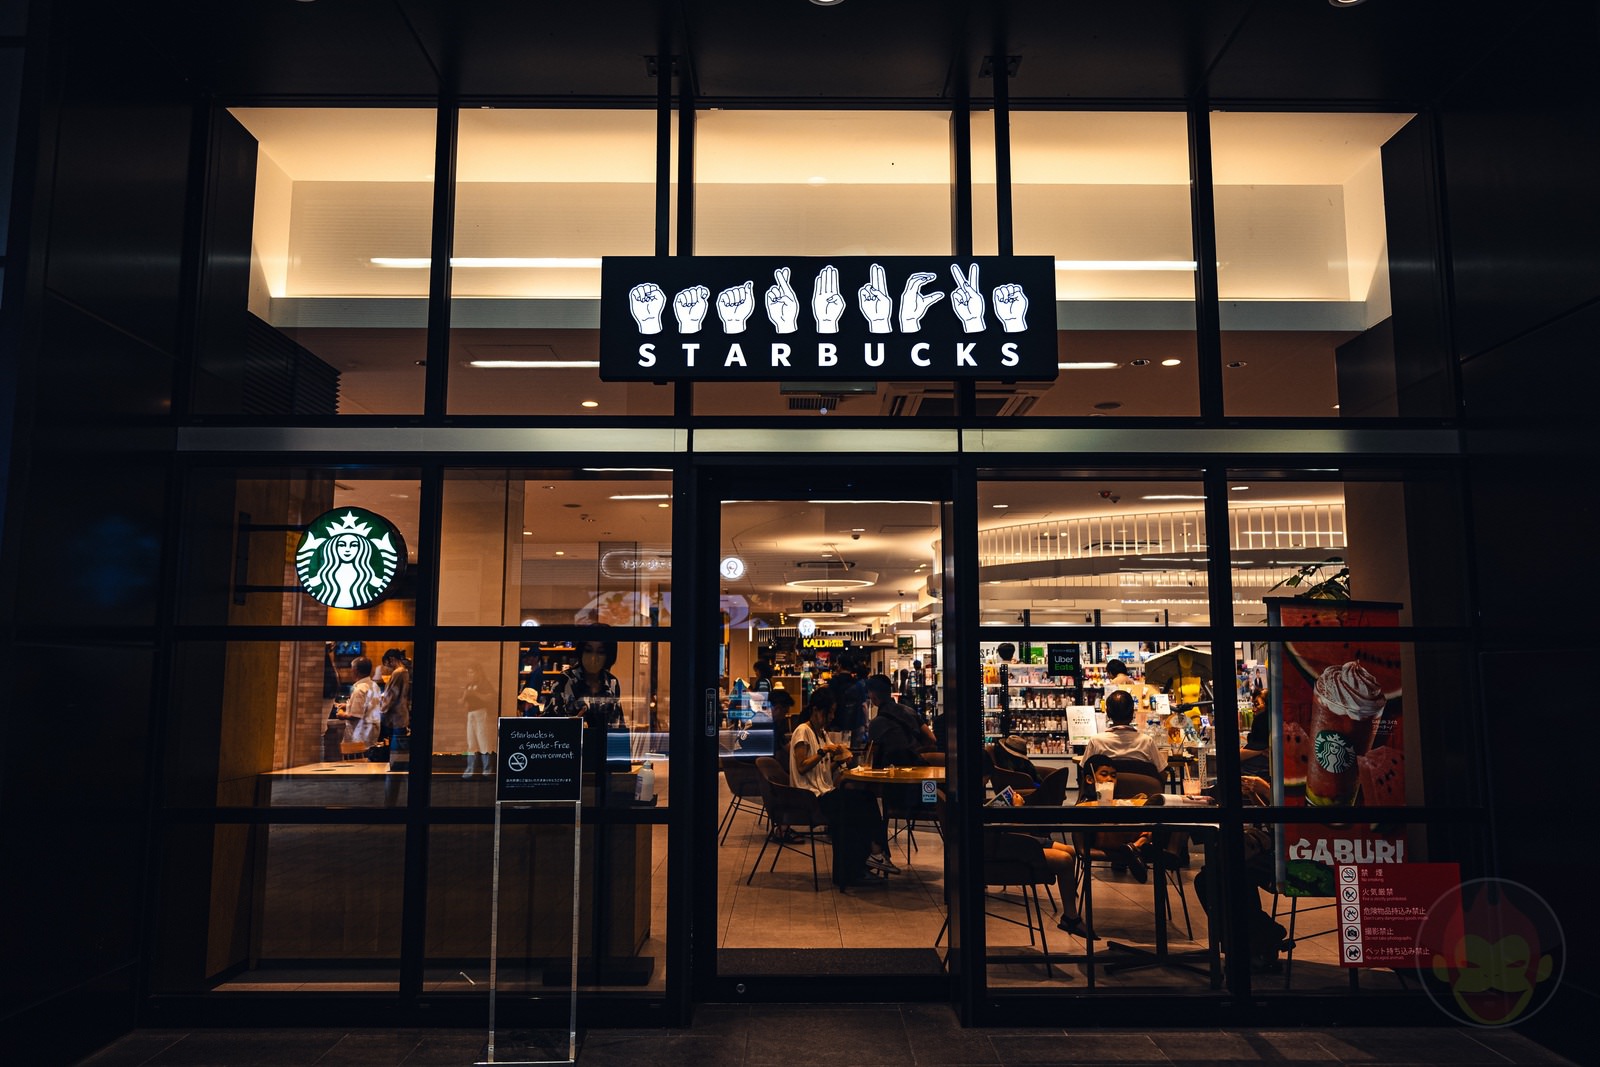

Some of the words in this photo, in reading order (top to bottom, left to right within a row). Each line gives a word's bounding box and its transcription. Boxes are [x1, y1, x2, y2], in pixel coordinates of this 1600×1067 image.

[637, 342, 1020, 368] STARBUCKS
[1054, 655, 1074, 663] Uber
[1054, 663, 1074, 671] Eats
[510, 730, 548, 739] Starbucks
[1289, 838, 1404, 866] GABURI
[1362, 888, 1394, 896] 火気厳禁
[1365, 927, 1395, 936] 撮影禁止
